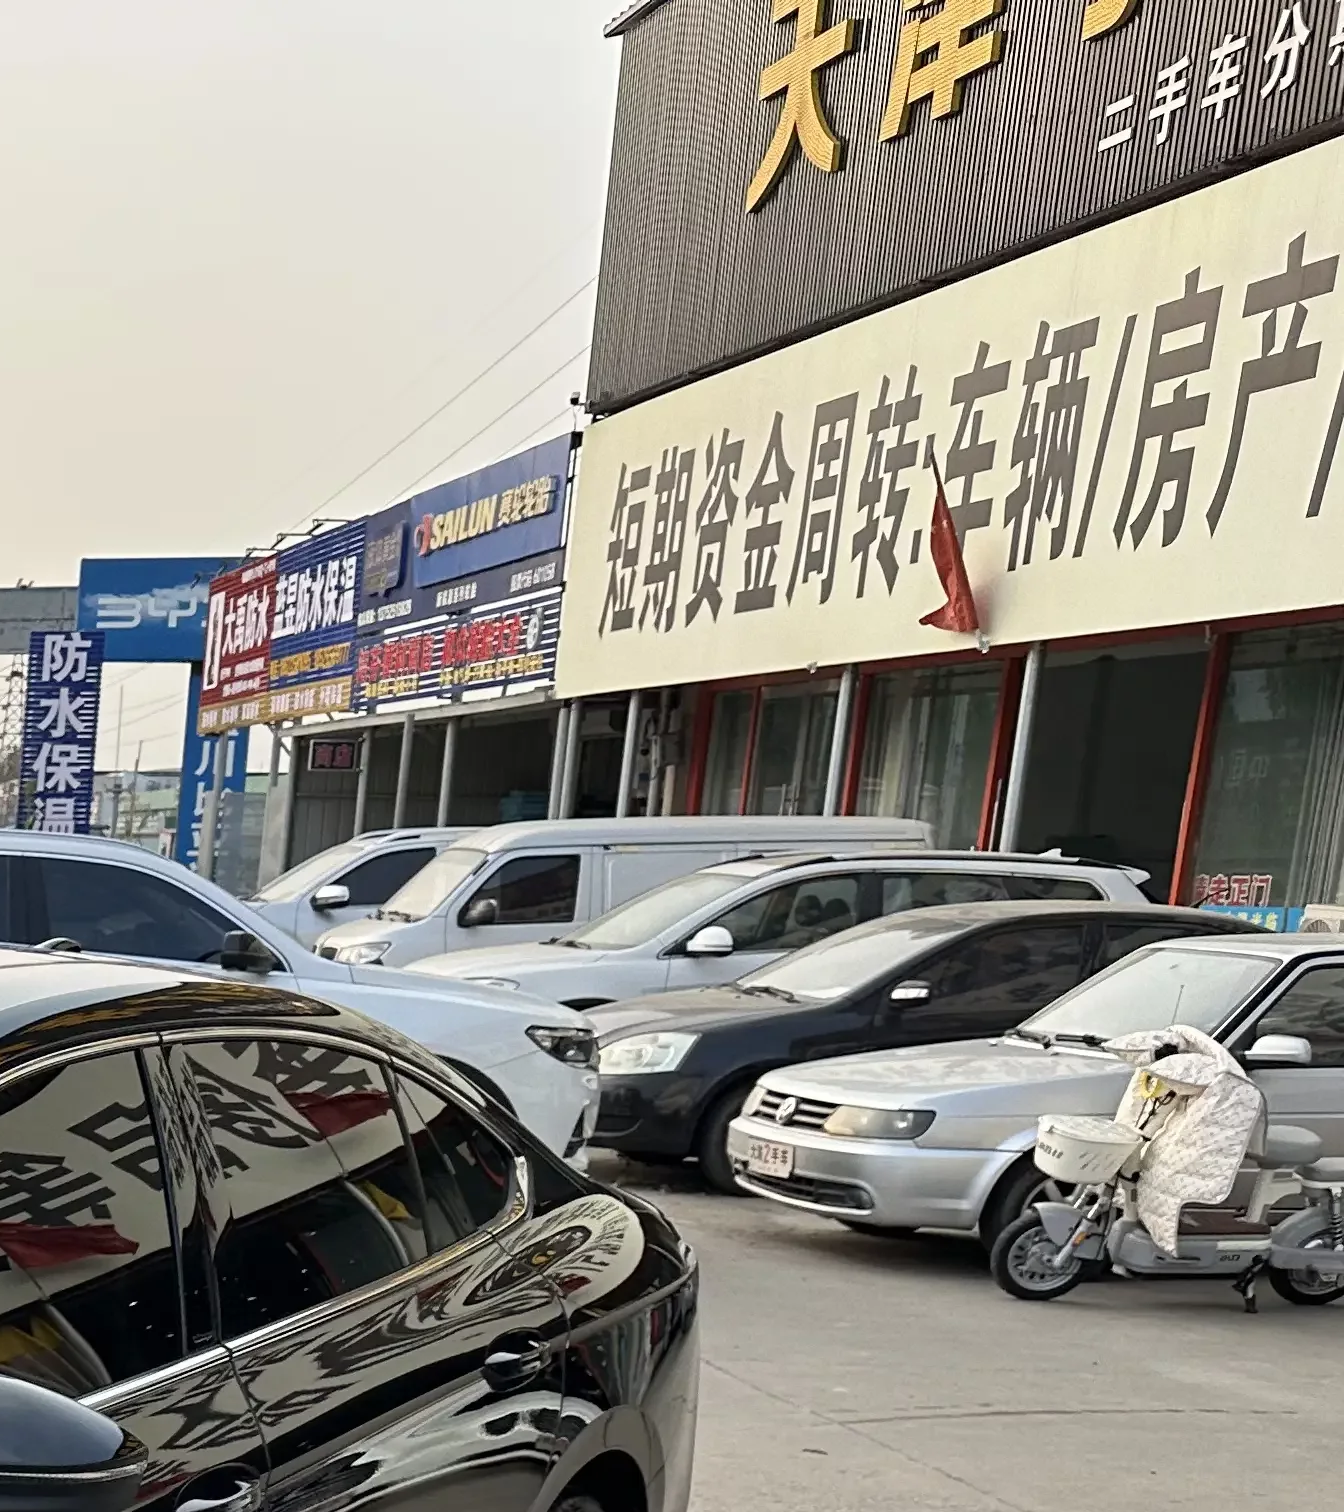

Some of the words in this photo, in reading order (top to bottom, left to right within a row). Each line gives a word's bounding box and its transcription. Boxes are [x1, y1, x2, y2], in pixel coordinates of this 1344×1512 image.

[746, 0, 1134, 213] 天津
[430, 494, 498, 550] SAILUN
[96, 593, 209, 629] BY
[222, 584, 271, 657] 大禹防水
[31, 632, 92, 835] 防水保温
